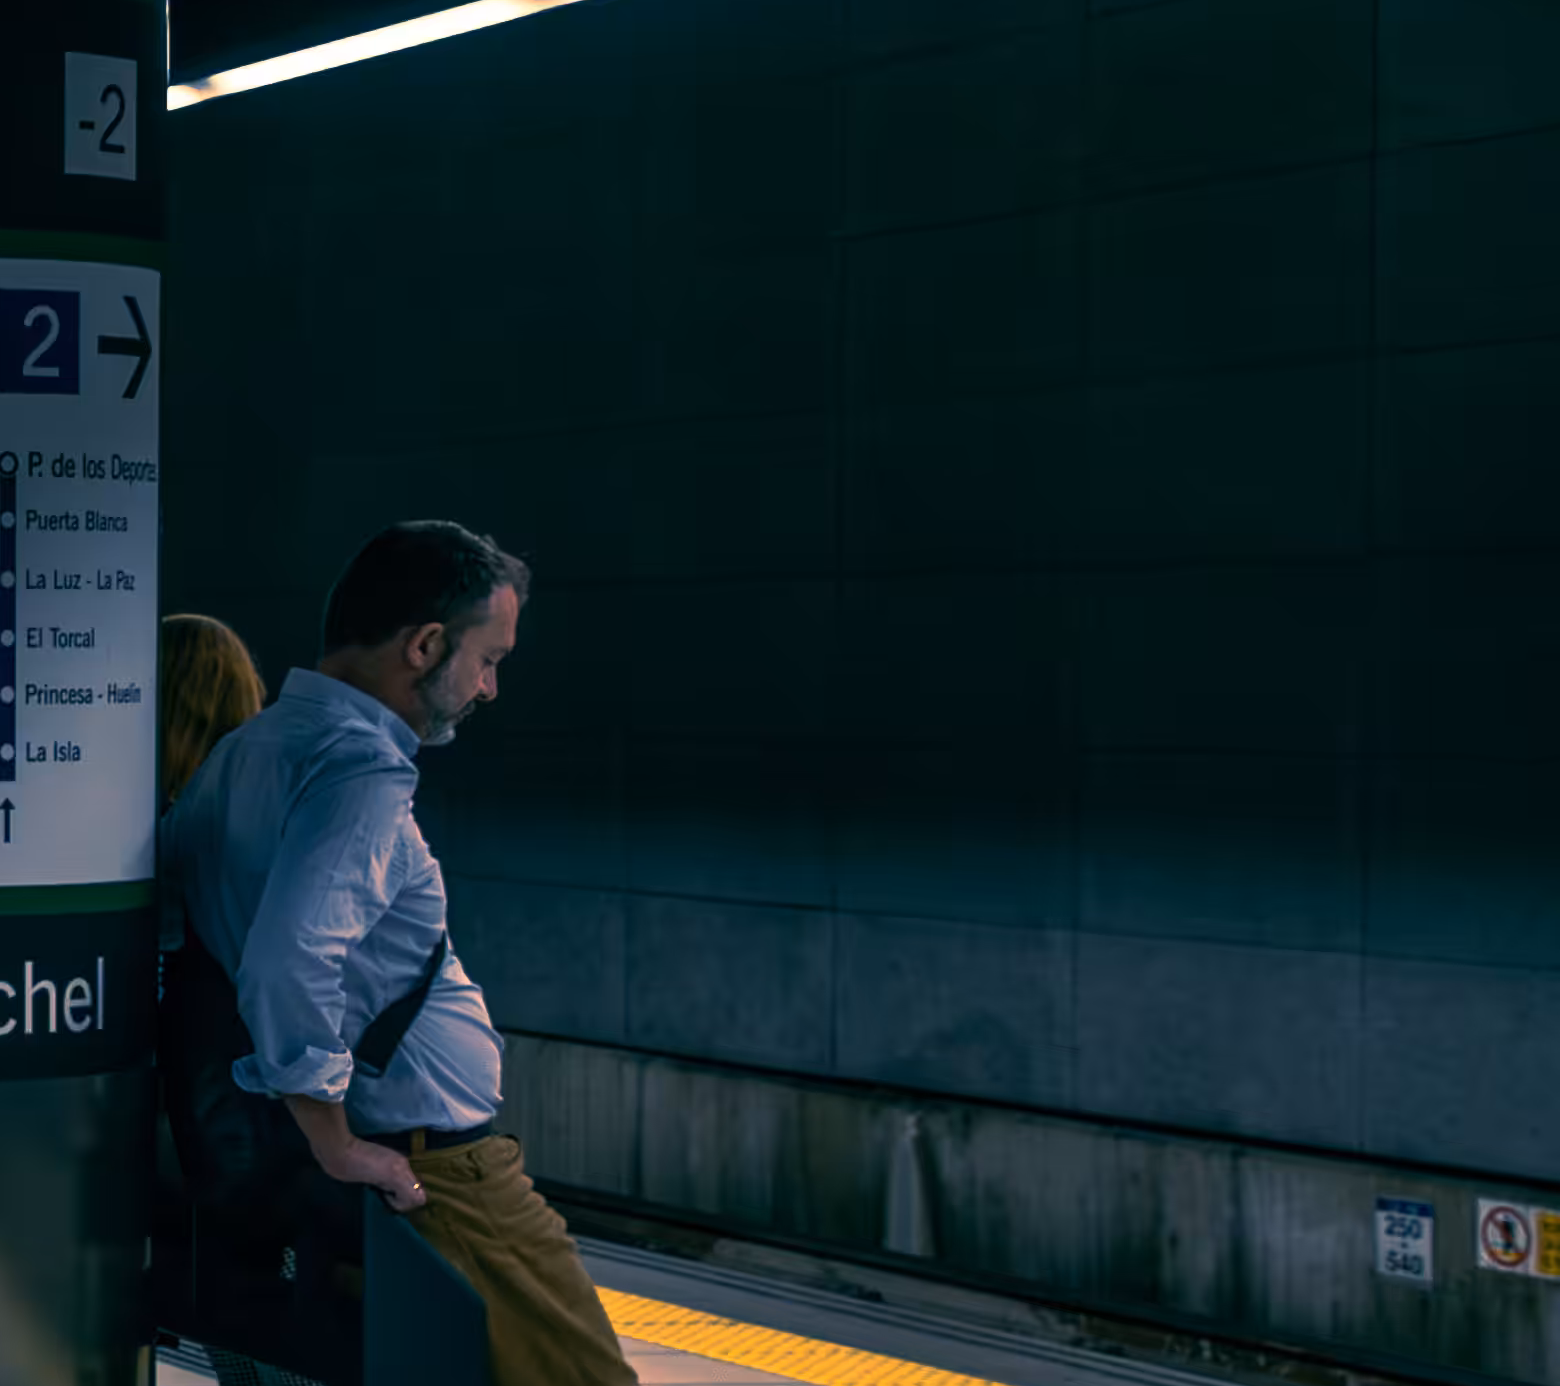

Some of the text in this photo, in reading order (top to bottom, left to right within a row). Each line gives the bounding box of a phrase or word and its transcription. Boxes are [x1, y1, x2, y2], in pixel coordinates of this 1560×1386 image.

[79, 84, 125, 154] -2
[22, 304, 60, 378] 2
[27, 451, 43, 478] P.
[51, 453, 75, 478] de
[83, 453, 105, 479] los
[26, 510, 128, 533] Puerta Blanca
[26, 569, 46, 590] La
[54, 569, 81, 590] Luz
[97, 569, 113, 591] La
[116, 570, 136, 591] Paz
[27, 627, 96, 649] El Torcal
[25, 683, 94, 705] Princesa
[26, 741, 81, 763] La Isla
